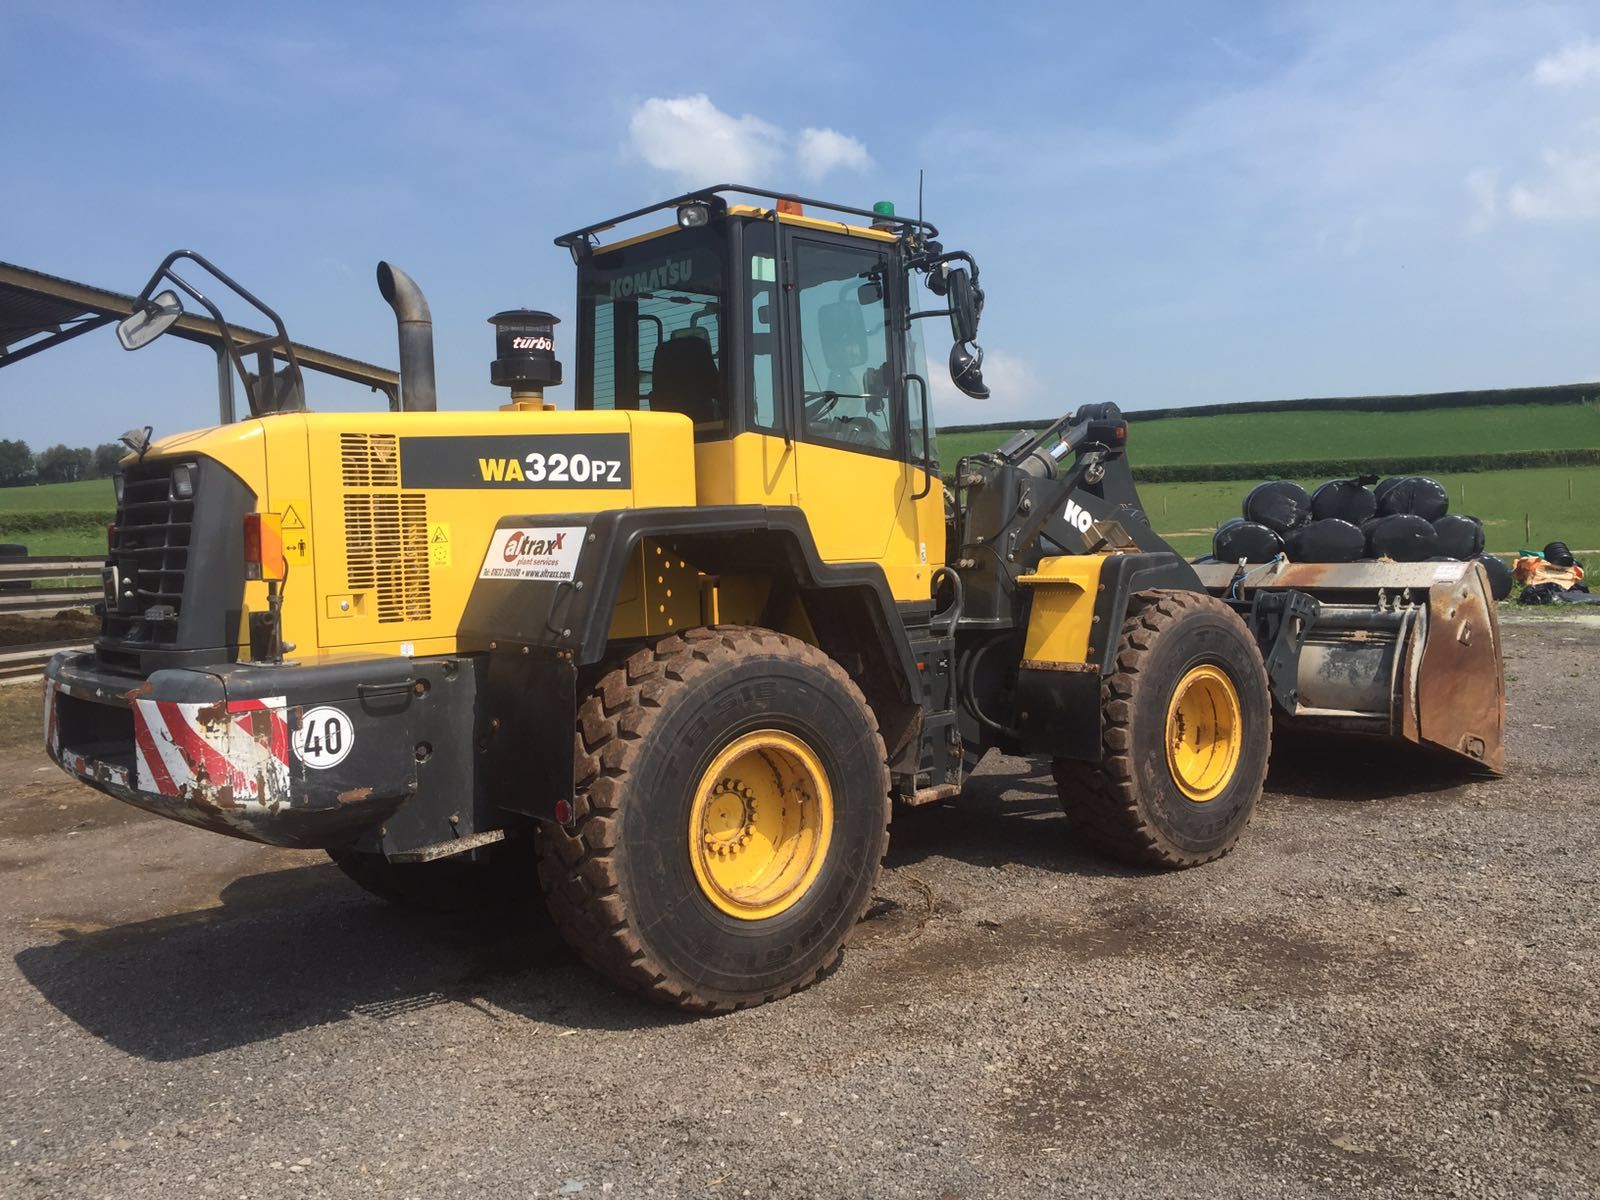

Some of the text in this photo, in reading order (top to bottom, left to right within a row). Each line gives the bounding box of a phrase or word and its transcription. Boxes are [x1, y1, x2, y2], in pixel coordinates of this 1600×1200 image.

[609, 259, 692, 299] KOMATSU
[513, 337, 552, 350] turbo
[479, 453, 621, 482] WA320PZ
[1063, 498, 1098, 533] KO
[533, 558, 559, 566] services
[304, 717, 341, 757] 40
